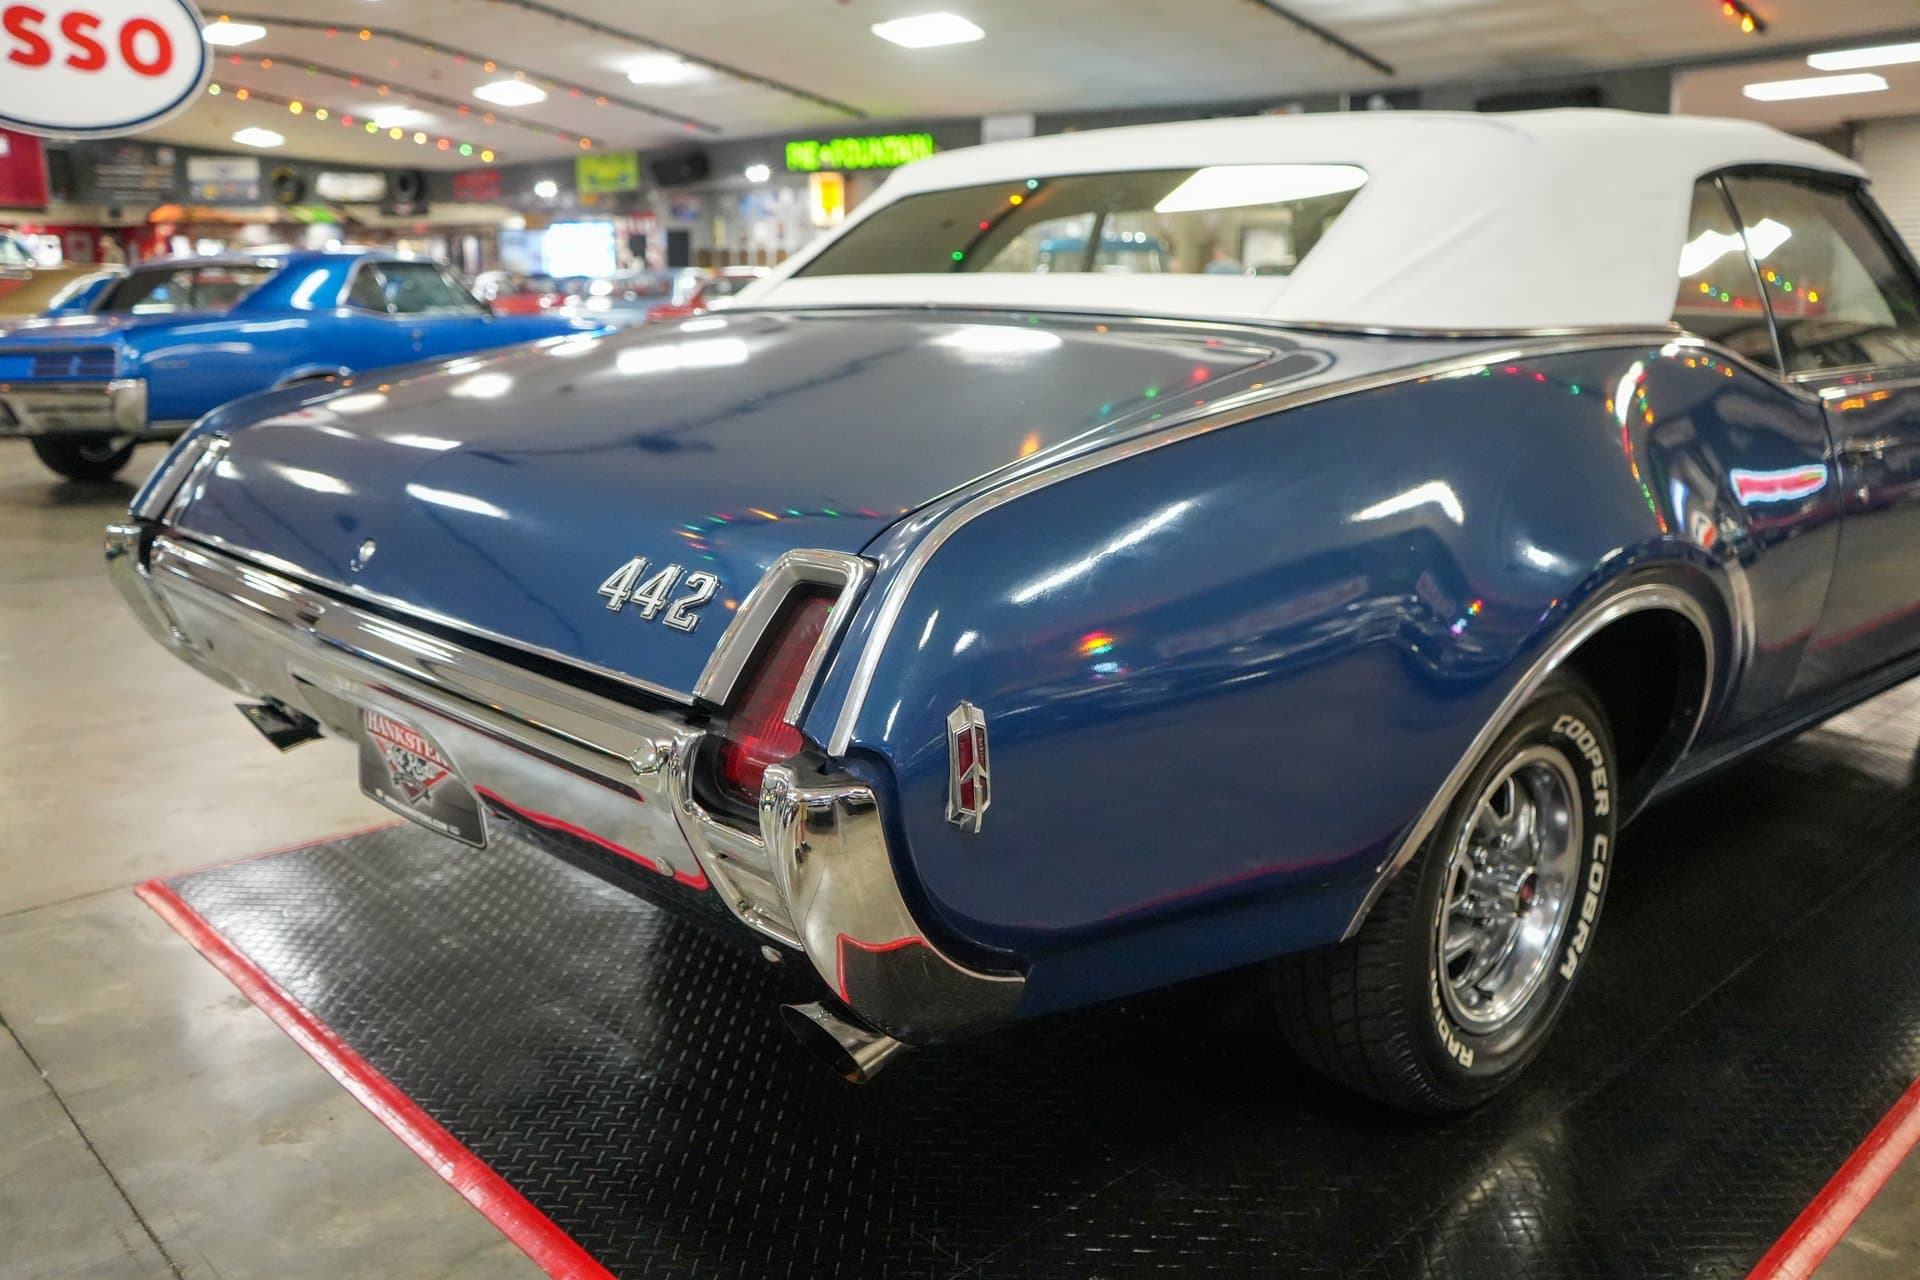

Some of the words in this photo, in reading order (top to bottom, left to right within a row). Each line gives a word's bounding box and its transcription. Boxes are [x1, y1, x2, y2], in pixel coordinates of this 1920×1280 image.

[597, 556, 721, 632] 442
[1552, 714, 1611, 817] COOPER
[1559, 833, 1609, 981] COBRA
